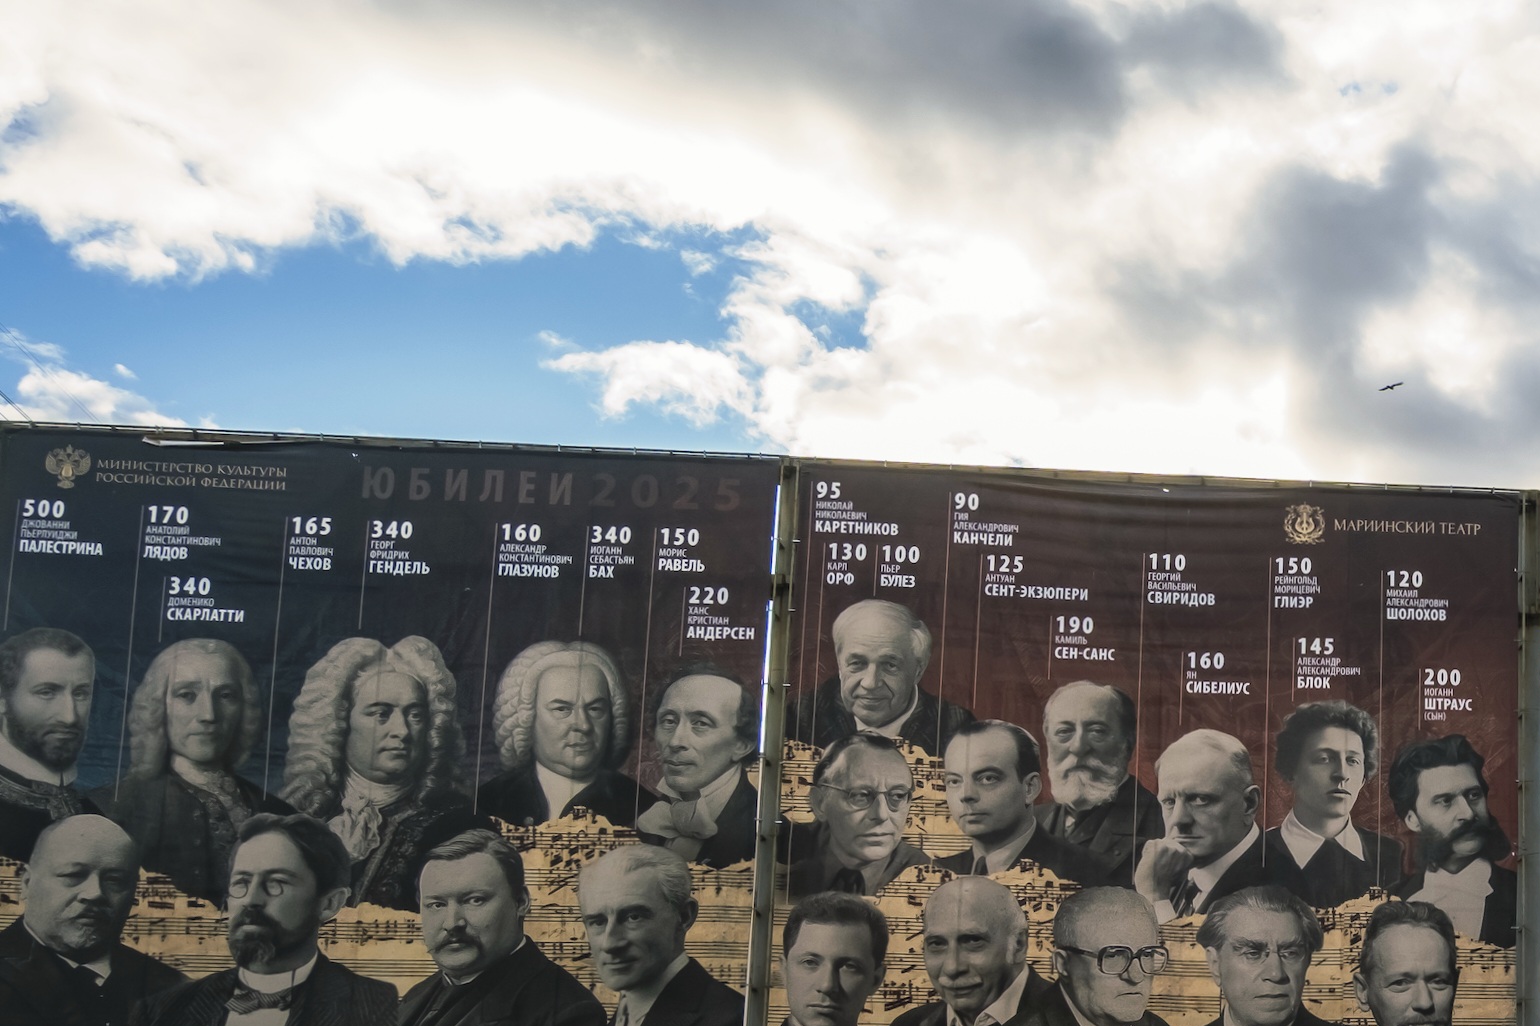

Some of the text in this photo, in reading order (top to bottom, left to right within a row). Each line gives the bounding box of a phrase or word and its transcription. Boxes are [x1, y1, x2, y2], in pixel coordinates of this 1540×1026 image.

[97, 459, 287, 478] МИНИСТЕРСТВО КУЛЬТУРЫ
[95, 472, 287, 491] РОССИЙСКОЙ ФЕДЕРАЦИИ
[589, 473, 742, 512] 2025
[816, 481, 841, 499] 95
[22, 499, 65, 518] 500
[815, 500, 853, 510] НИКОЛАЙ
[954, 492, 980, 511] 90
[148, 505, 189, 524] 170
[815, 510, 867, 520] НИКОЛАЕВИЧ
[953, 512, 969, 520] ГИЯ
[21, 519, 70, 530] ДЖОВАННИ
[146, 525, 190, 535] АНАТОЛИЙ
[292, 516, 332, 535] 165
[371, 520, 413, 539] 340
[815, 520, 899, 536] КАРЕТНИКОВ
[953, 521, 1019, 533] АЛЕКСАНДРОВИЧ
[1334, 518, 1481, 536] МАРИИНСКИЙ ТЕАТР
[20, 529, 78, 540] ПЬЕРЛУИДЖИ
[501, 523, 541, 542] 160
[591, 525, 632, 544] 340
[660, 527, 700, 546] 150
[953, 531, 1013, 546] КАНЧЕЛИ
[19, 539, 103, 555] ПАЛЕСТРИНА
[145, 535, 221, 546] КОНСТАНТИНОВИЧ
[290, 536, 317, 545] АНТОН
[370, 540, 396, 550] ГЕОРГ
[143, 545, 188, 561] ЛЯДОВ
[289, 546, 334, 556] ПАВЛОВИЧ
[369, 550, 410, 560] ФРИДРИХ
[499, 543, 547, 554] АЛЕКСАНДР
[590, 545, 622, 555] ИОГАНН
[658, 548, 687, 557] МОРИС
[829, 542, 867, 561] 130
[882, 545, 920, 563] 100
[288, 556, 332, 571] ЧЕХОВ
[499, 553, 573, 564] КОНСТАНТИНОВИЧ
[589, 554, 635, 564] СЕБАСТЬЯН
[658, 558, 706, 572] РАВЕЛЬ
[986, 554, 1024, 573] 125
[1149, 553, 1186, 571] 110
[369, 560, 430, 576] ГЕНДЕЛЬ
[498, 563, 560, 578] ГЛАЗУНОВ
[589, 565, 615, 578] БАХ
[827, 562, 848, 571] КАРЛ
[880, 564, 901, 573] ПЬЕР
[1275, 557, 1312, 575] 150
[826, 571, 855, 585] ОРФ
[880, 574, 916, 588] БУЛЕЗ
[985, 573, 1015, 583] АНТУАН
[1148, 571, 1181, 581] ГЕОРГИЙ
[1274, 575, 1318, 586] РЕЙНГОЛЬД
[1386, 570, 1423, 588] 120
[168, 576, 211, 595] 340
[984, 583, 1089, 601] СЕНТ-ЭКЗЮПЕРИ
[1147, 581, 1197, 591] ВАСИЛЬЕВИЧ
[1274, 585, 1321, 595] МОРИЦЕВИЧ
[688, 586, 729, 605] 220
[1147, 591, 1216, 607] СВИРИДОВ
[1386, 589, 1418, 598] МИХАИЛ
[167, 596, 215, 607] ДОМЕНИКО
[1274, 596, 1314, 609] ГЛИЭР
[1386, 598, 1449, 608] АЛЕКСАНДРОВИЧ
[166, 607, 245, 623] СКАРЛАТТИ
[688, 606, 710, 615] ХАНС
[1386, 608, 1447, 622] ШОЛОХОВ
[687, 615, 730, 625] КРИСТИАН
[1056, 615, 1094, 634] 190
[686, 626, 755, 641] АНДЕРСЕН
[1055, 635, 1088, 645] КАМИЛЬ
[1298, 637, 1335, 655] 145
[1054, 646, 1115, 661] СЕН-САНС
[1187, 651, 1225, 670] 160
[1297, 657, 1341, 667] АЛЕКСАНДР
[1186, 670, 1197, 680] ЯН
[1297, 666, 1361, 677] АЛЕКСАНДРОВИЧ
[1424, 669, 1461, 686] 200
[1186, 680, 1250, 695] СИБЕЛИУС
[1297, 676, 1331, 689] БЛОК
[1424, 688, 1454, 697] ИОГАНН
[1424, 698, 1473, 711] ШТРАУС
[1424, 711, 1446, 721] (СЫН)
